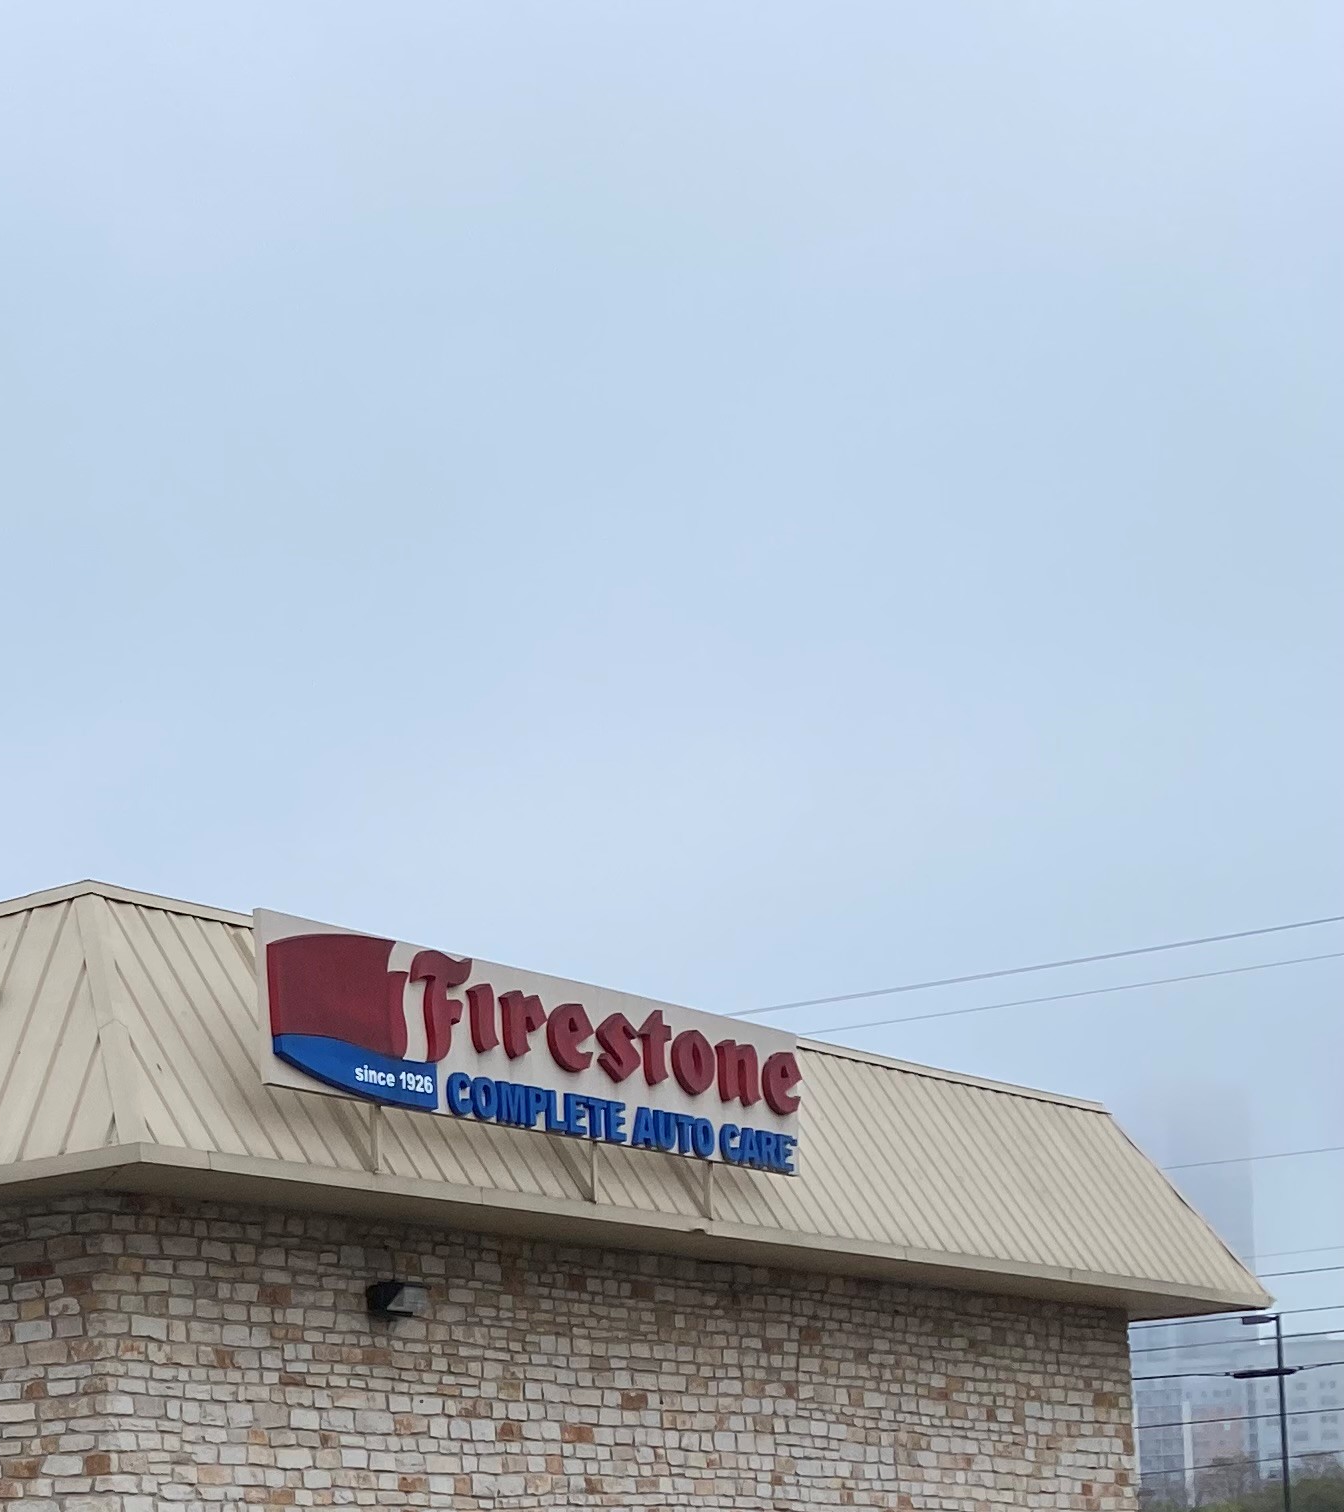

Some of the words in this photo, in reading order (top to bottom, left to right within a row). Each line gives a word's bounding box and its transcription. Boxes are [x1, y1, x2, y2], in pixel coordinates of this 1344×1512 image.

[355, 1064, 397, 1087] since
[399, 1070, 434, 1094] 1926
[410, 949, 801, 1115] Firestone
[446, 1072, 627, 1143] COMPLETE
[632, 1107, 714, 1158] AUTO
[719, 1123, 797, 1174] CARE
